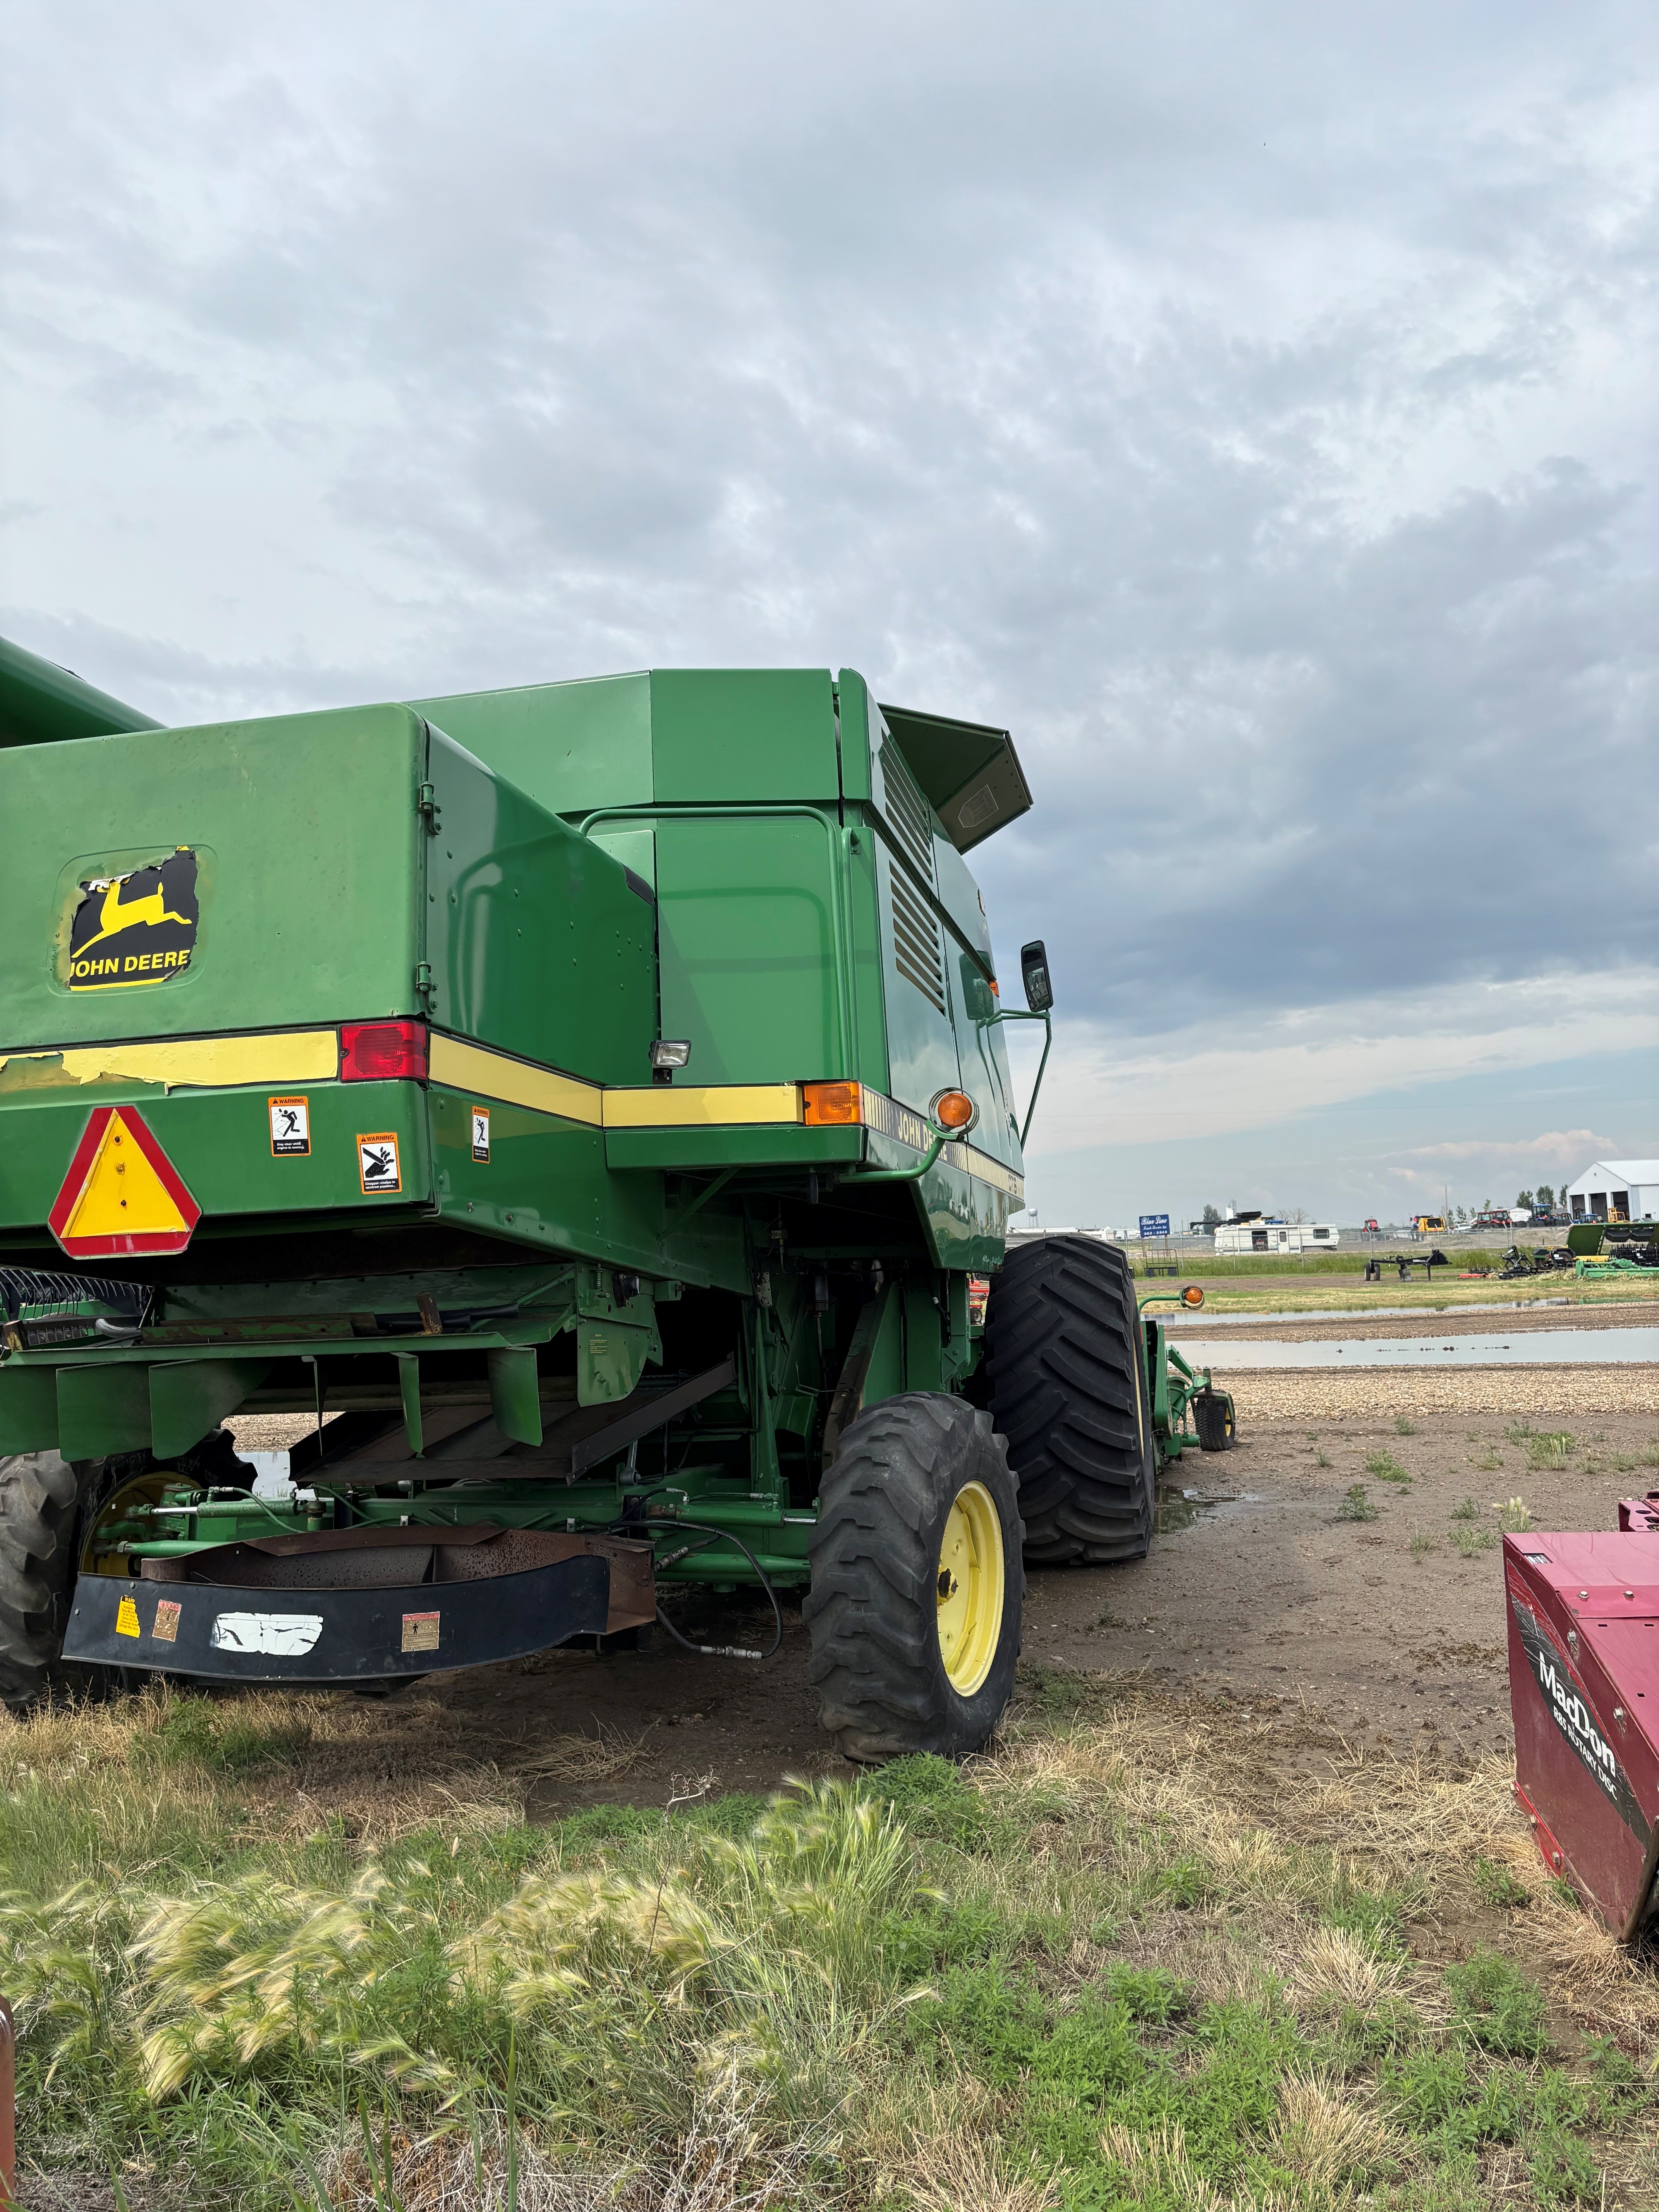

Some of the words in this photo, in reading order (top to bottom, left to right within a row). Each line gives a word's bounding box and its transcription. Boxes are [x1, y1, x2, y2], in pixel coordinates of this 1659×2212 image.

[70, 958, 119, 977] JOHN
[124, 950, 190, 972] DEERE
[898, 1111, 921, 1148] JOHN
[1141, 1217, 1155, 1225] Blue
[1155, 1216, 1168, 1224] Line
[1540, 1650, 1616, 1778] MacDon
[1553, 1705, 1567, 1731] R85
[1568, 1724, 1596, 1772] ROTARY
[1597, 1764, 1617, 1801] DISC
